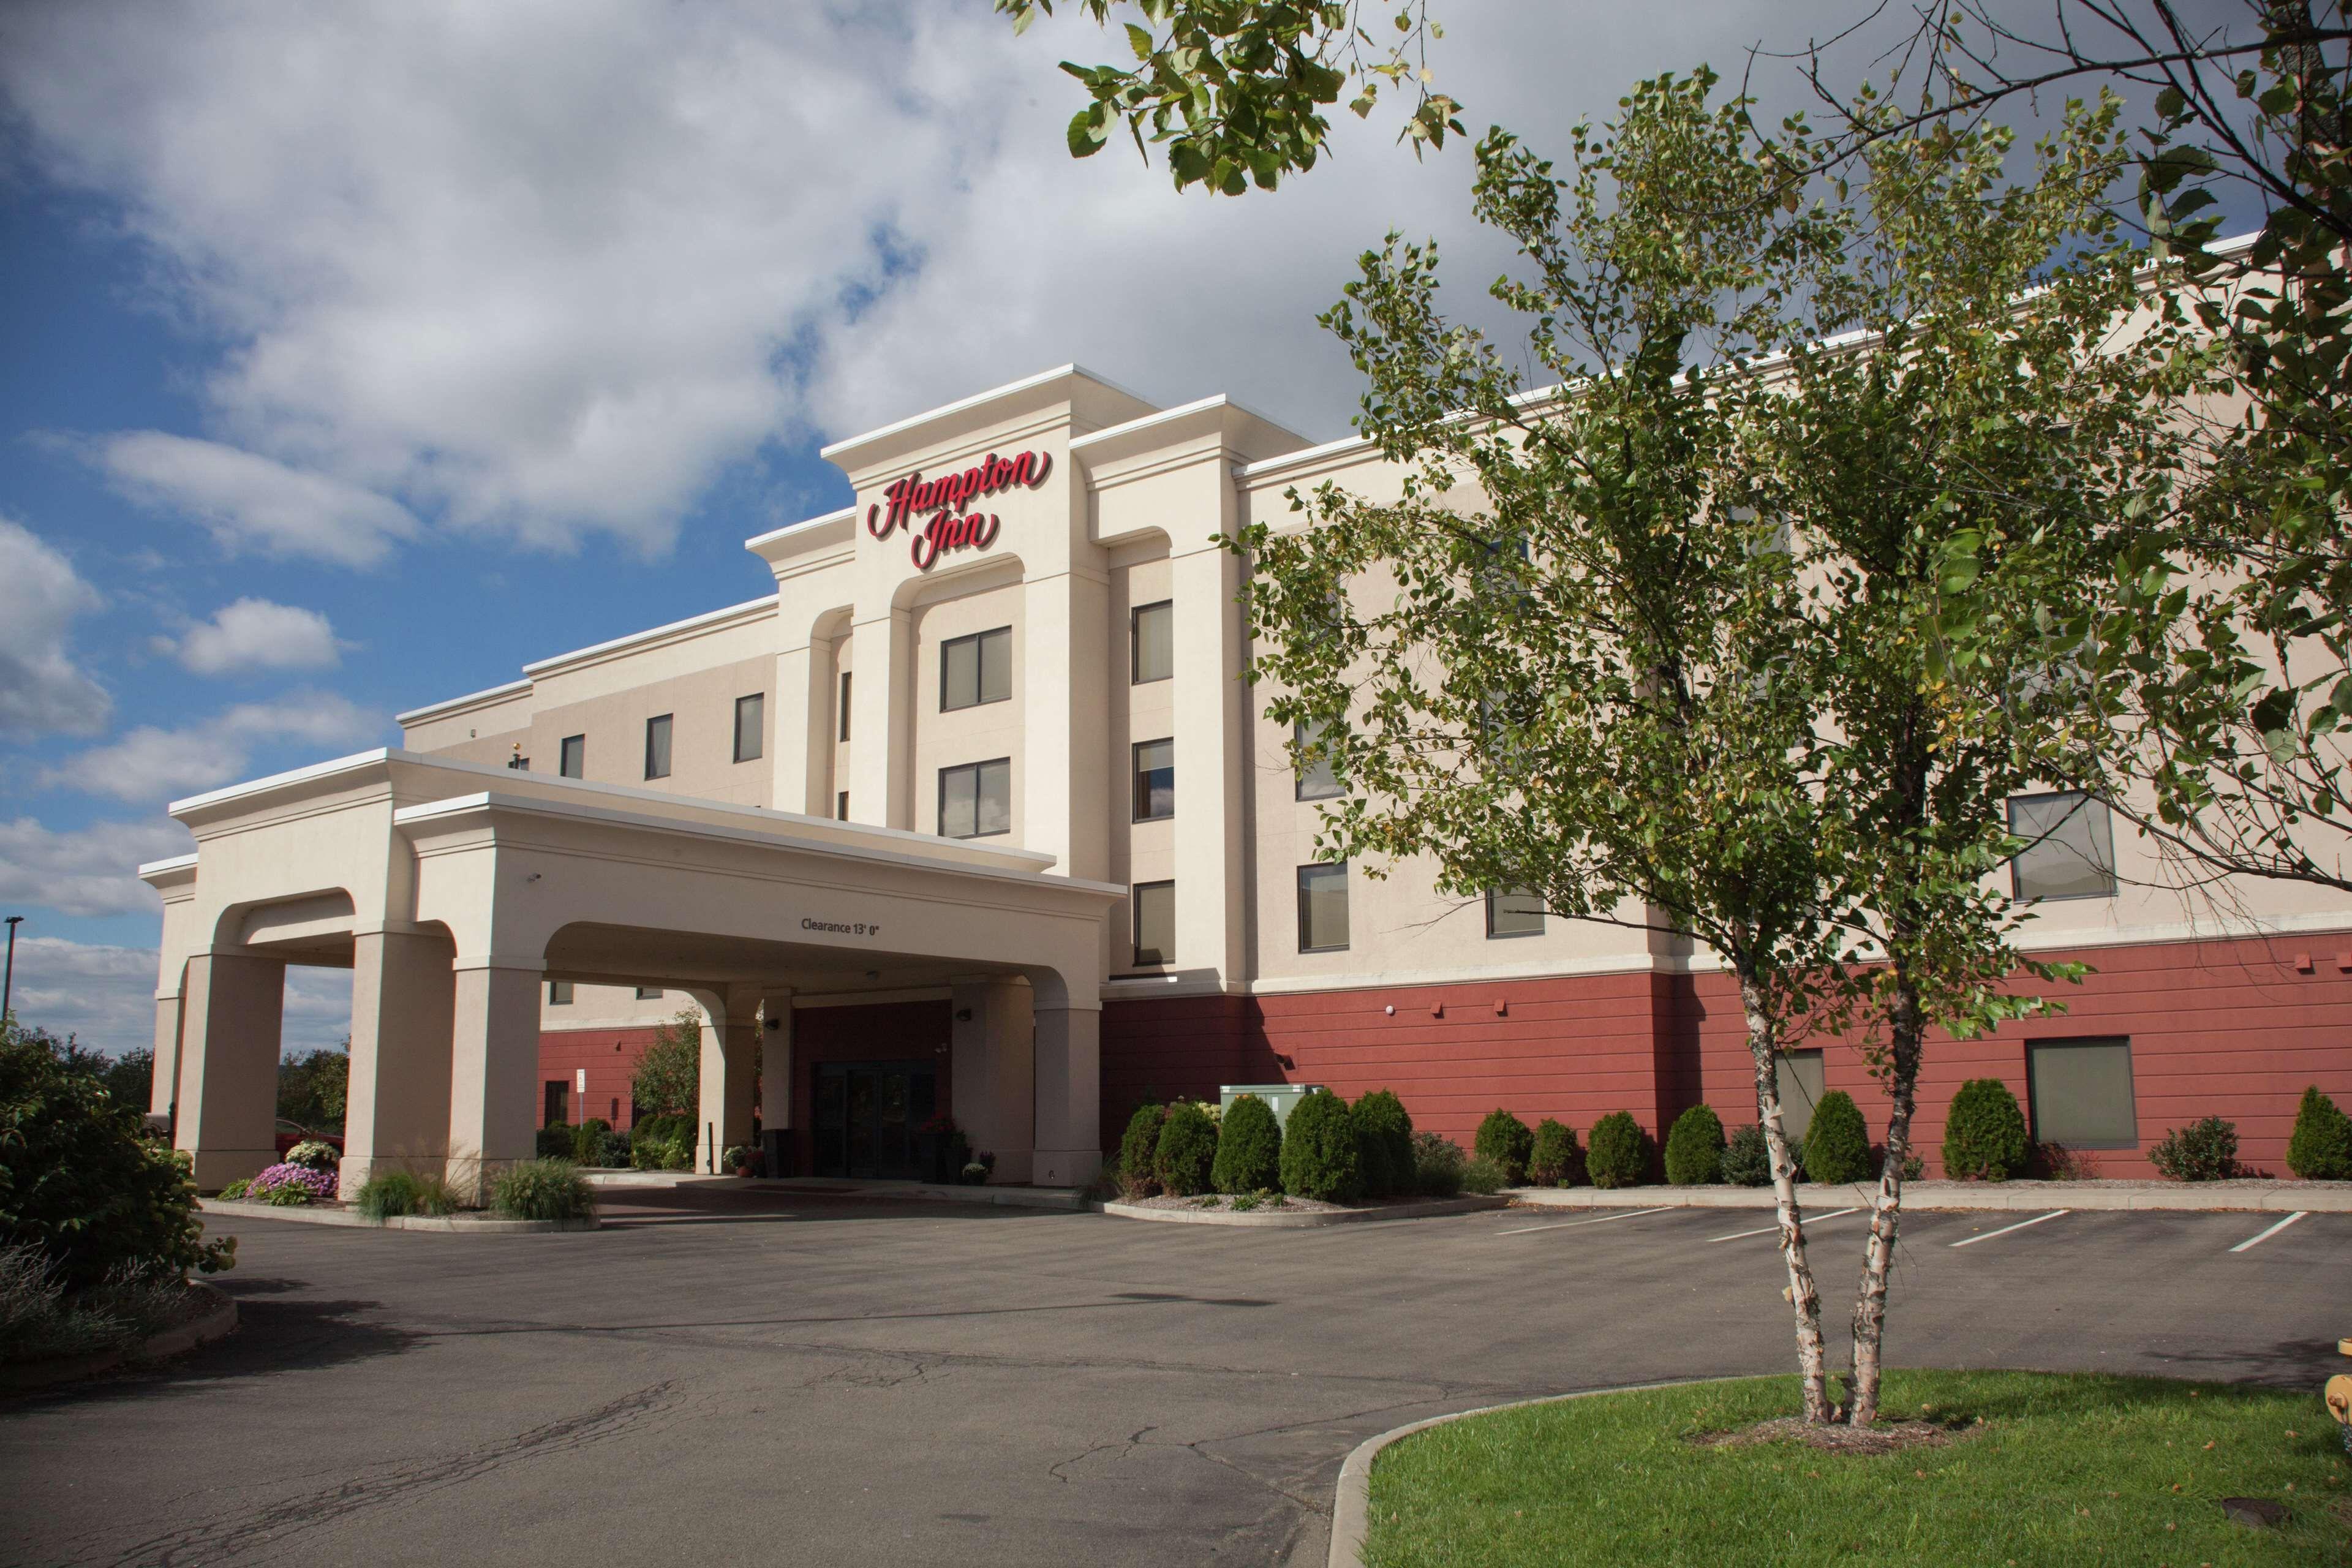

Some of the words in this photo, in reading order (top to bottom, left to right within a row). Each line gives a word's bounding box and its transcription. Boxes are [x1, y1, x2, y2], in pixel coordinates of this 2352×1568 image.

[867, 451, 1052, 537] Hampton
[911, 509, 1000, 569] Inn
[801, 918, 851, 933] Clearance
[853, 923, 867, 935] 13'
